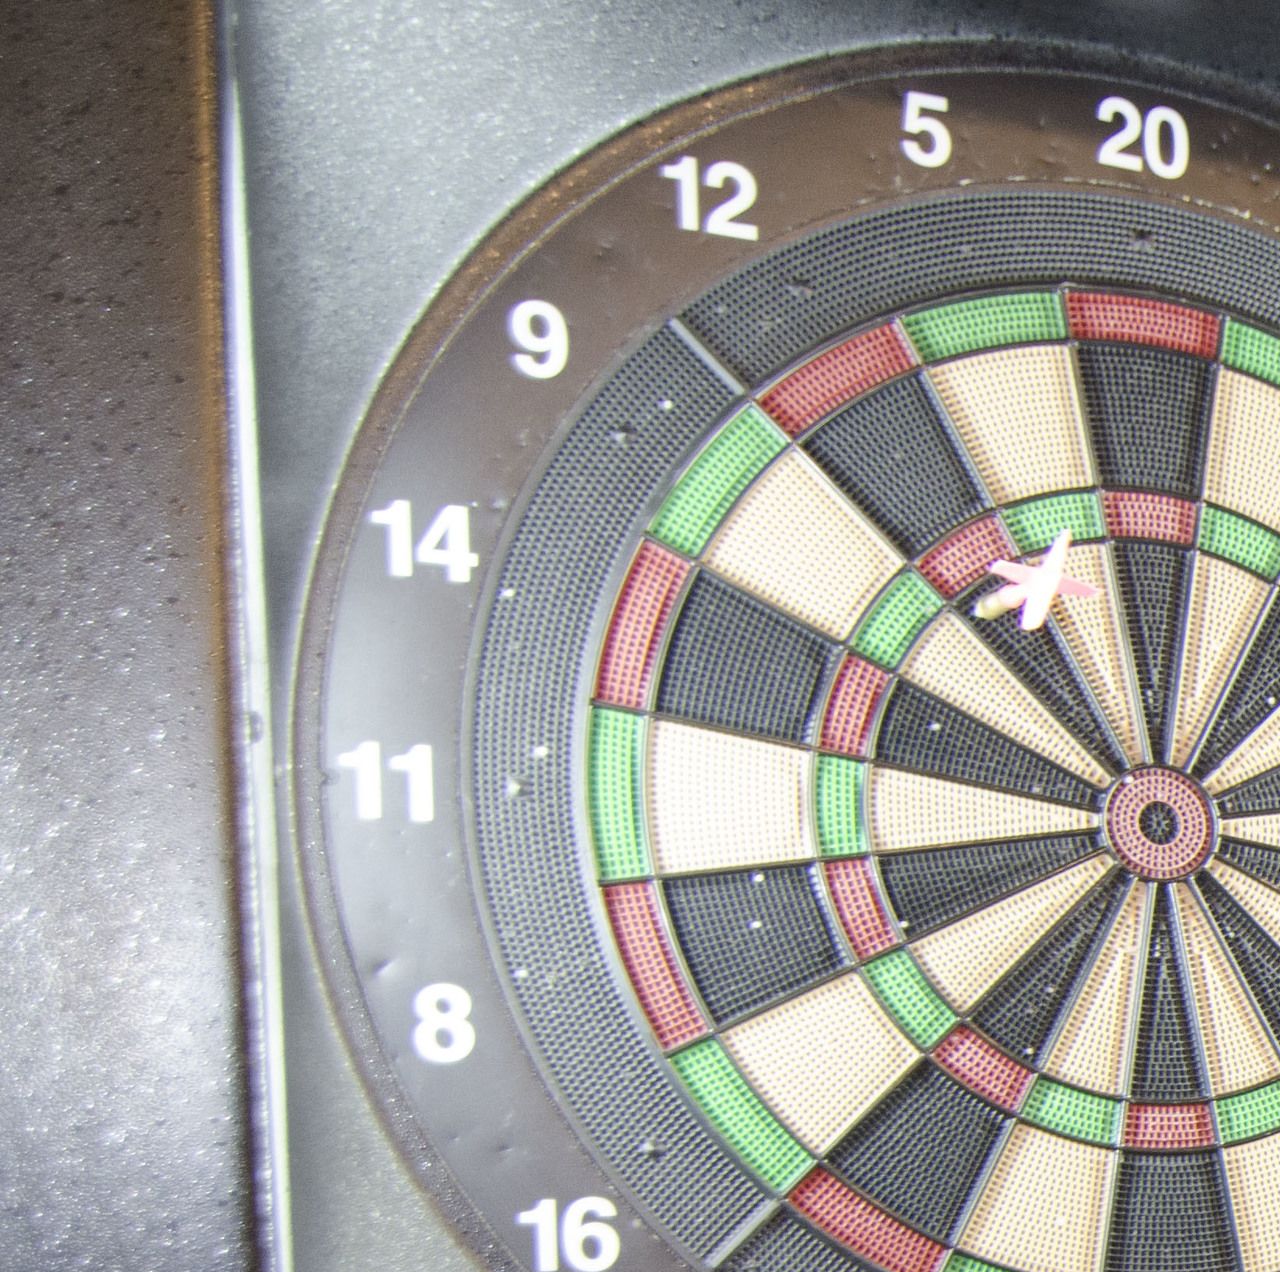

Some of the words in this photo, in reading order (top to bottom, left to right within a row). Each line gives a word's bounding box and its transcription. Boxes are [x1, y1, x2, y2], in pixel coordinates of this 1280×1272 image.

[902, 92, 952, 168] 5
[1097, 97, 1190, 180] 20
[660, 156, 760, 242] 12
[507, 300, 569, 380] 9
[371, 499, 479, 584] 14
[338, 738, 435, 823] 11
[411, 981, 477, 1065] 8
